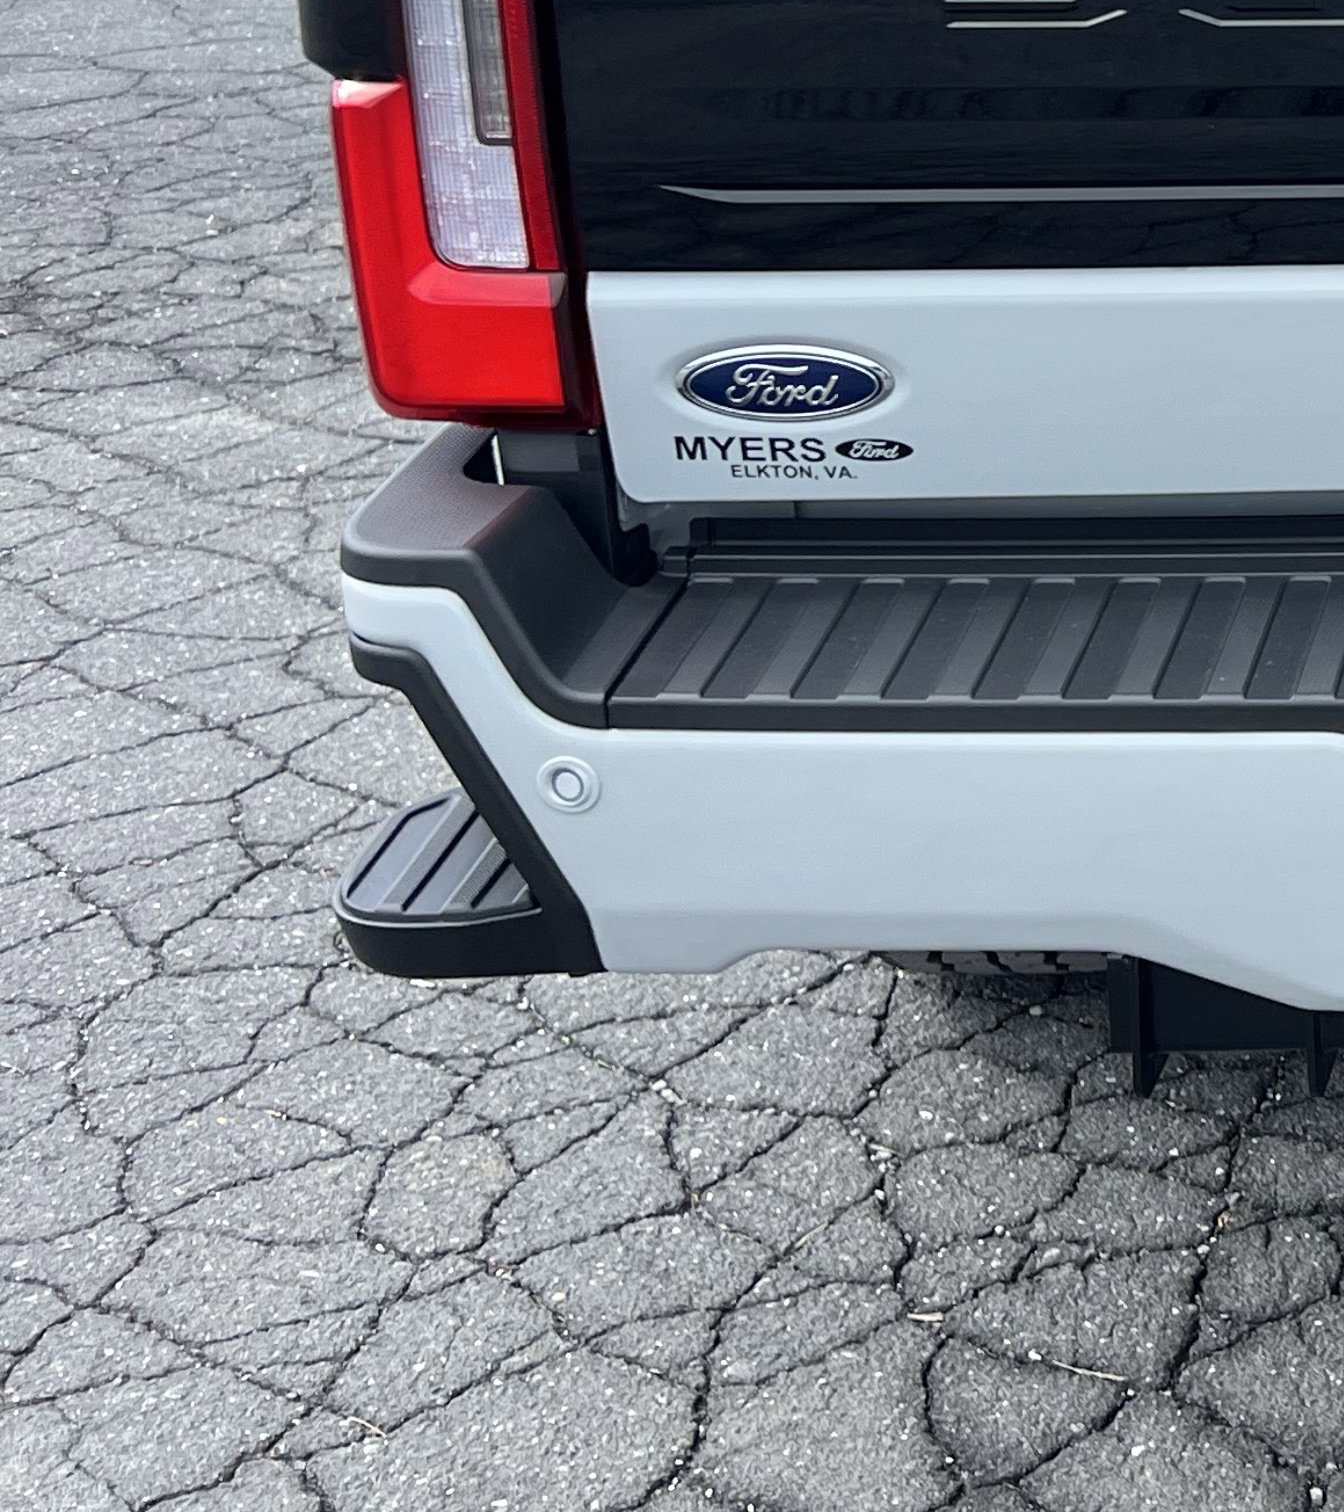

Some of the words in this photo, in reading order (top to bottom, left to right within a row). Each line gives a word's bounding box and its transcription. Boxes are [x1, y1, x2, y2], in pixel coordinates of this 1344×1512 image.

[725, 362, 839, 407] Ford
[673, 435, 827, 463] MYERS
[848, 440, 900, 460] Ford
[730, 464, 819, 481] ELKTON,
[824, 465, 858, 480] VA.
